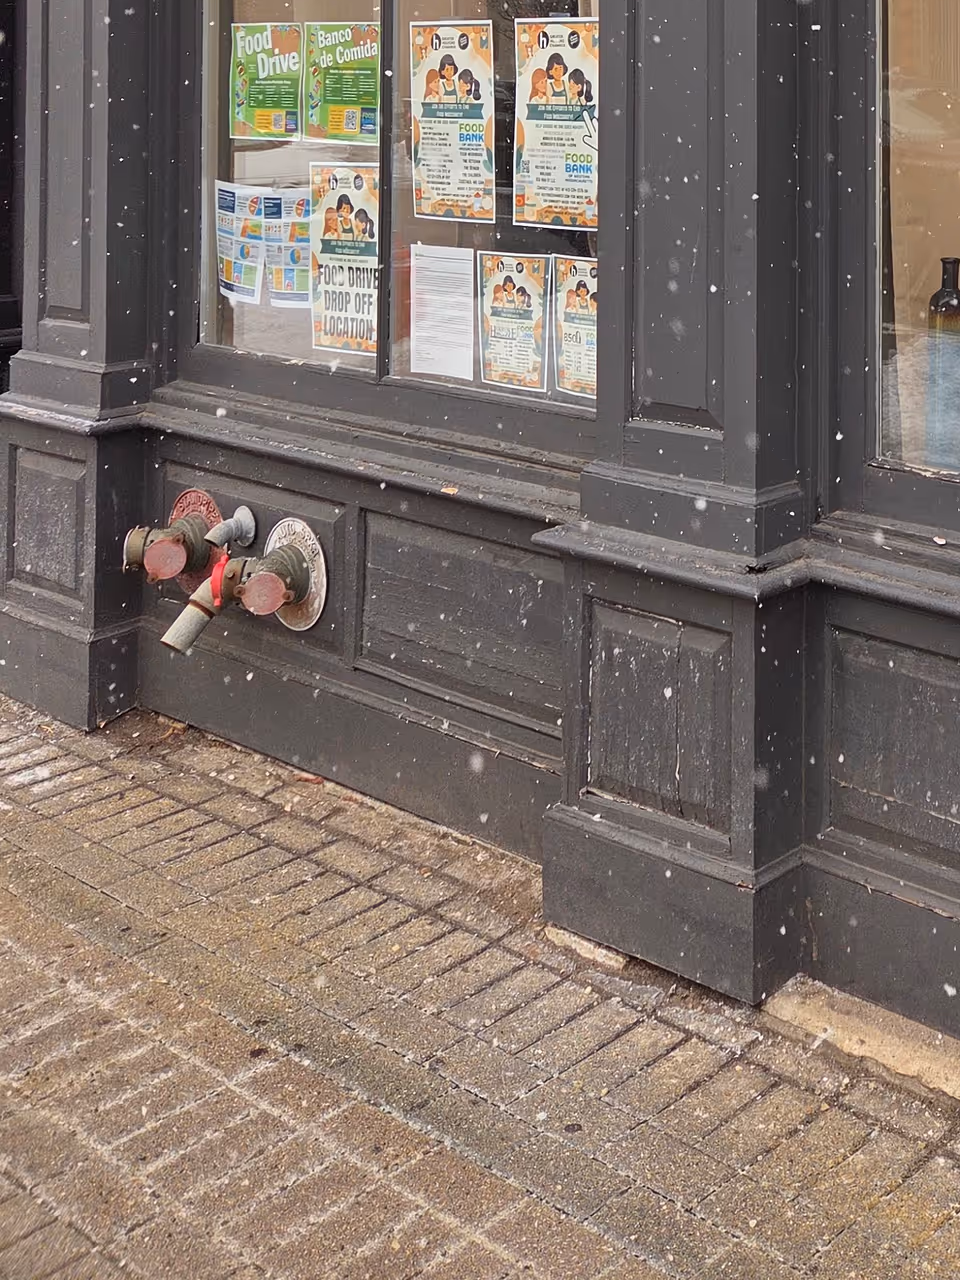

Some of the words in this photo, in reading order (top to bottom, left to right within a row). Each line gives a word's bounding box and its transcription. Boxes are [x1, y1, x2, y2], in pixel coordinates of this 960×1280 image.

[236, 24, 272, 57] Food
[317, 28, 352, 48] Banco
[257, 48, 299, 79] Drive
[320, 51, 333, 68] de
[336, 39, 378, 64] Comida
[459, 123, 484, 132] FOOD
[459, 133, 484, 142] BANK
[565, 153, 593, 163] FOOD
[565, 163, 593, 174] BANK
[318, 264, 344, 287] FOOD
[348, 264, 379, 289] DRIVE
[324, 290, 351, 314] DROP
[354, 293, 373, 315] OFF
[323, 314, 373, 341] LOCATION
